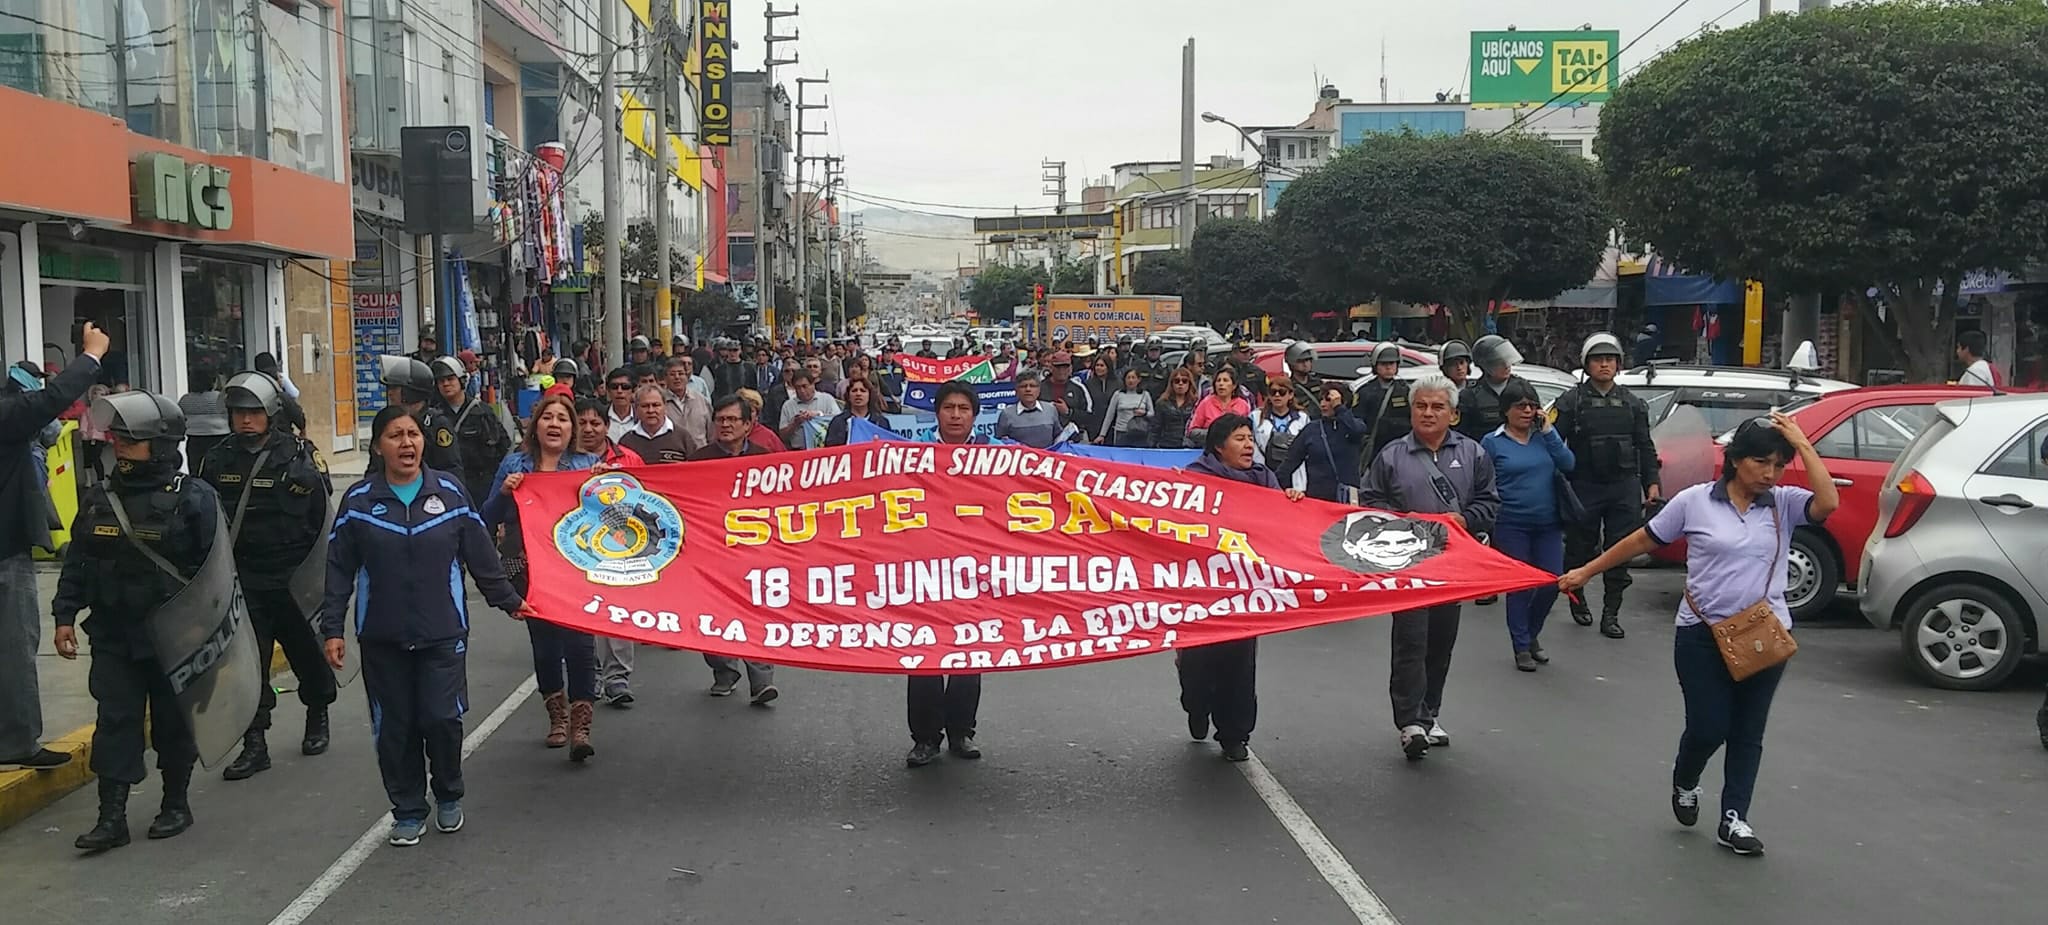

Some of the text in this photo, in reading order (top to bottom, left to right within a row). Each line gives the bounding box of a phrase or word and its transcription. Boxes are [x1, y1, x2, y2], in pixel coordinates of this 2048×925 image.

[1481, 39, 1544, 57] UBÍCANOS
[1481, 56, 1511, 77] AQUÍ
[1053, 311, 1091, 321] CENTRO
[1093, 311, 1146, 321] COMERCIAL
[902, 358, 937, 375] SUTE
[731, 463, 794, 498] ¡POR
[800, 453, 851, 488] UNA
[863, 443, 935, 480] LÍNEA
[946, 446, 1068, 481] SINDICAL
[724, 488, 928, 547] SUTE
[745, 566, 791, 608] 18
[807, 564, 857, 606] DE
[699, 614, 748, 642] LA
[763, 620, 937, 650] DEFENSA
[953, 618, 1006, 645] DE
[1021, 614, 1073, 642] LA
